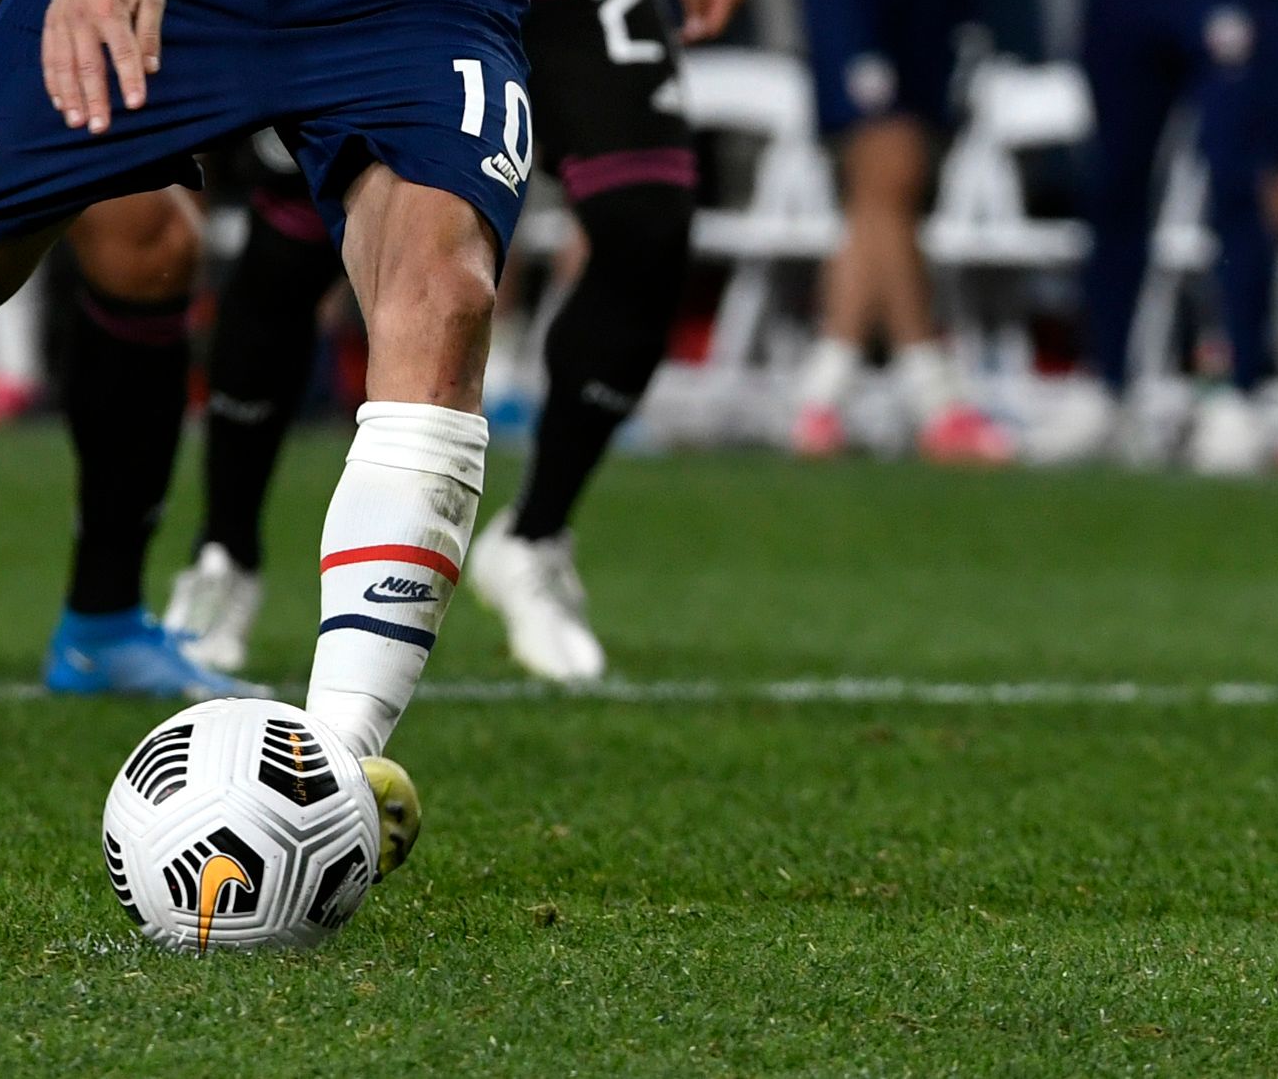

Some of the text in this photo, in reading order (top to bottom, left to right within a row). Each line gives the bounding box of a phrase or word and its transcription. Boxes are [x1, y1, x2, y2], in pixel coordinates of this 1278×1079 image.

[452, 59, 534, 182] 10
[492, 152, 521, 188] NIKE
[379, 576, 433, 599] NIKE
